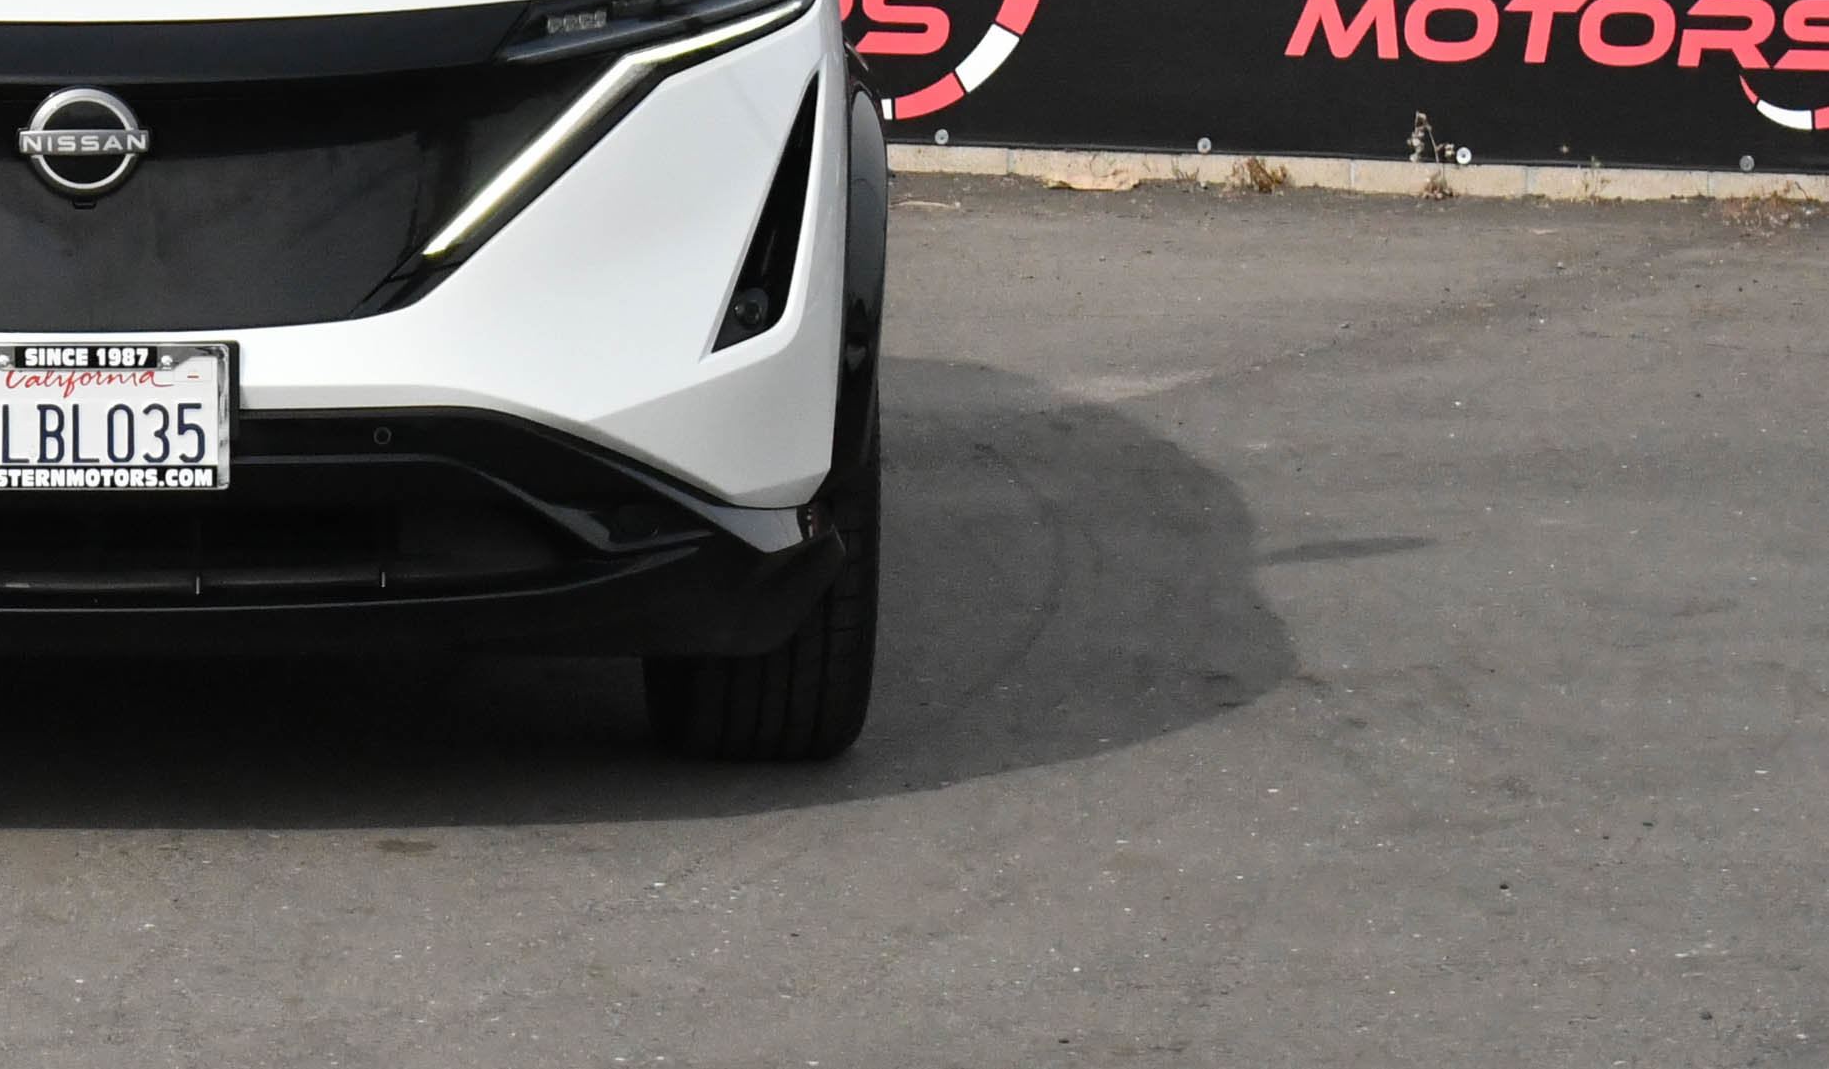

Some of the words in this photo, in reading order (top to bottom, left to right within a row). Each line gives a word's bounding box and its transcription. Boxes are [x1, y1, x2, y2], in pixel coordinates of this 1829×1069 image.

[22, 134, 147, 152] NISSAN
[24, 347, 89, 367] SINCE
[96, 347, 149, 367] 1987
